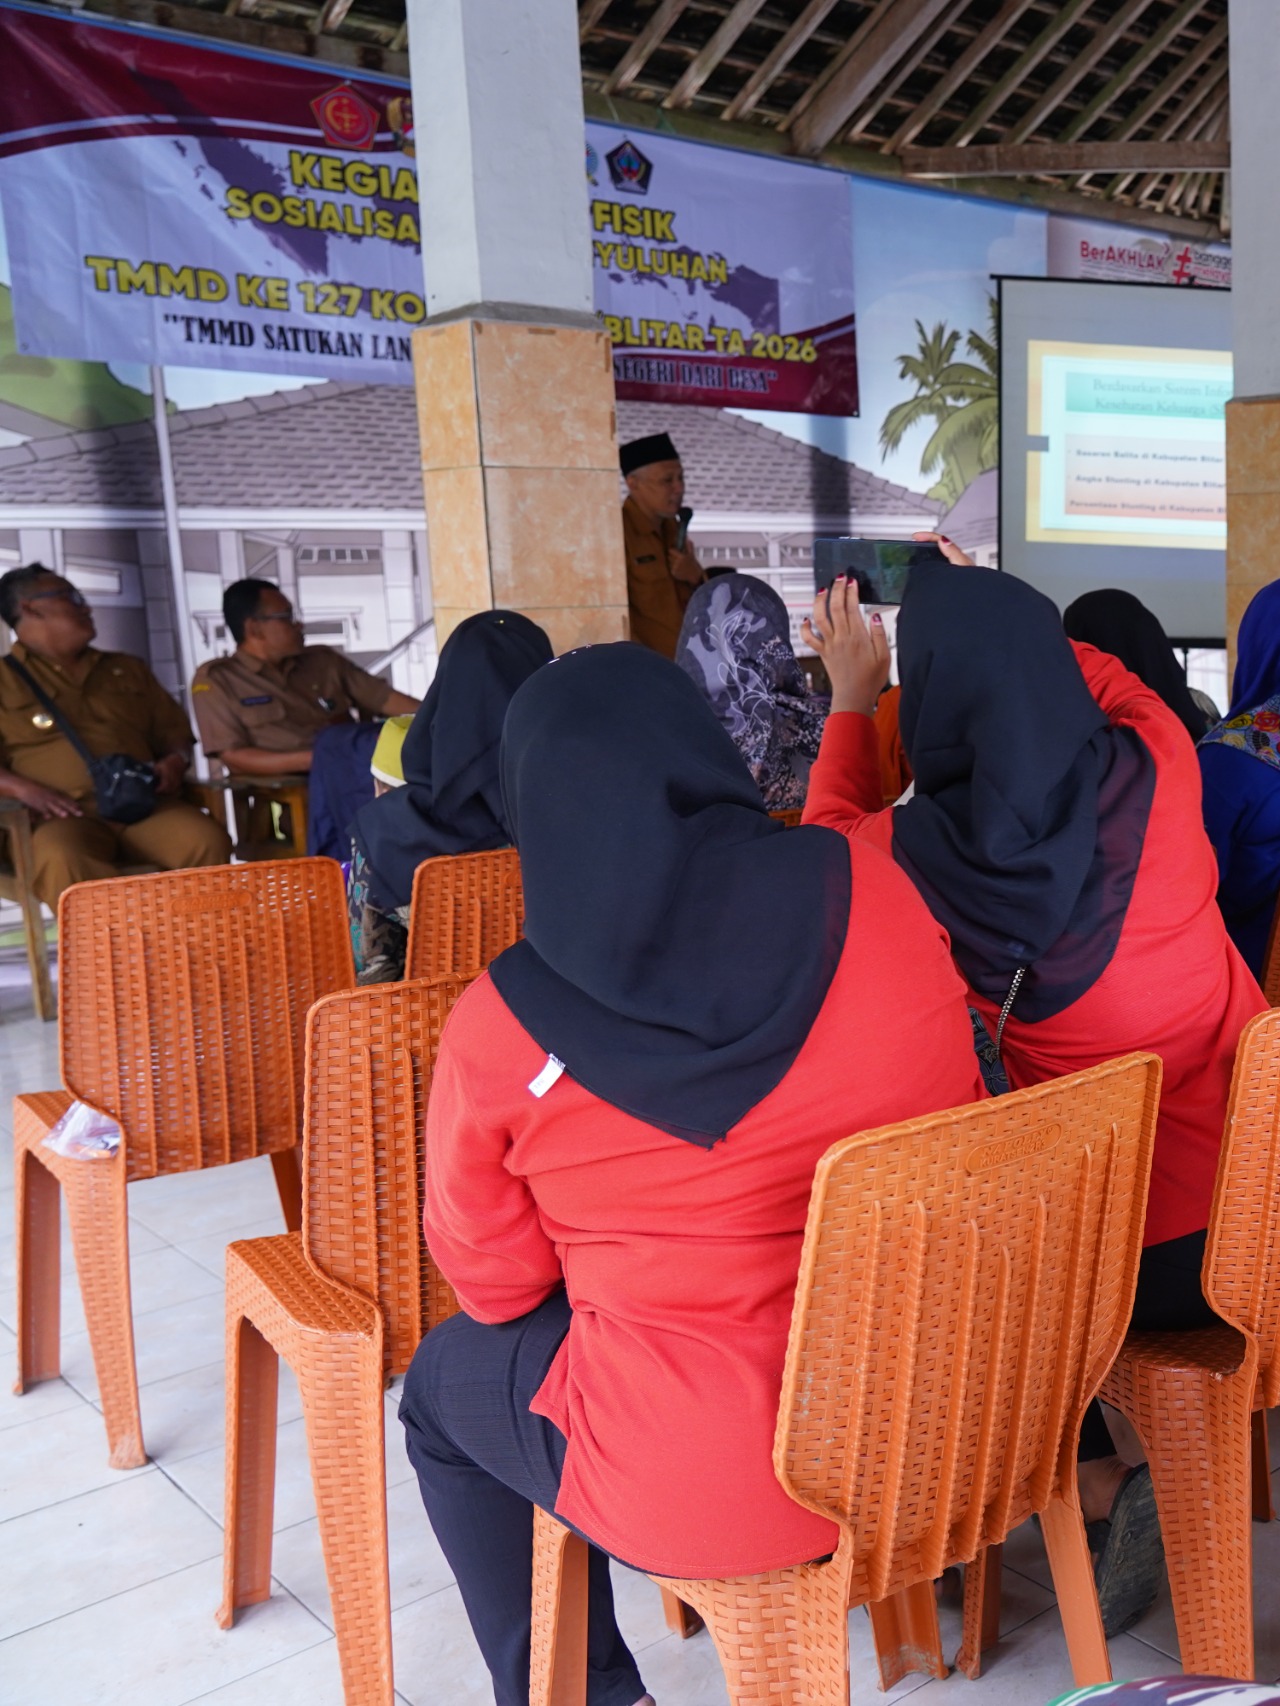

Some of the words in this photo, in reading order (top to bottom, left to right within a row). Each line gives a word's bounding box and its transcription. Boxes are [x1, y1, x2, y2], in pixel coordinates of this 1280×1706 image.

[226, 186, 421, 244] SOSIALISA
[593, 240, 728, 284] YULUHAN
[289, 150, 419, 203] KEGIA
[591, 199, 677, 243] FISIK
[1080, 240, 1164, 270] BerAKHLAK
[84, 255, 229, 302] TMMD
[236, 272, 290, 311] KE
[297, 280, 363, 318] 127
[370, 288, 426, 324] KO
[598, 312, 705, 352] BLITAR
[710, 325, 746, 356] TA
[751, 331, 818, 363] 2026
[263, 324, 363, 358] SATUKAN
[371, 334, 411, 361] LAN
[680, 360, 723, 389] DARI
